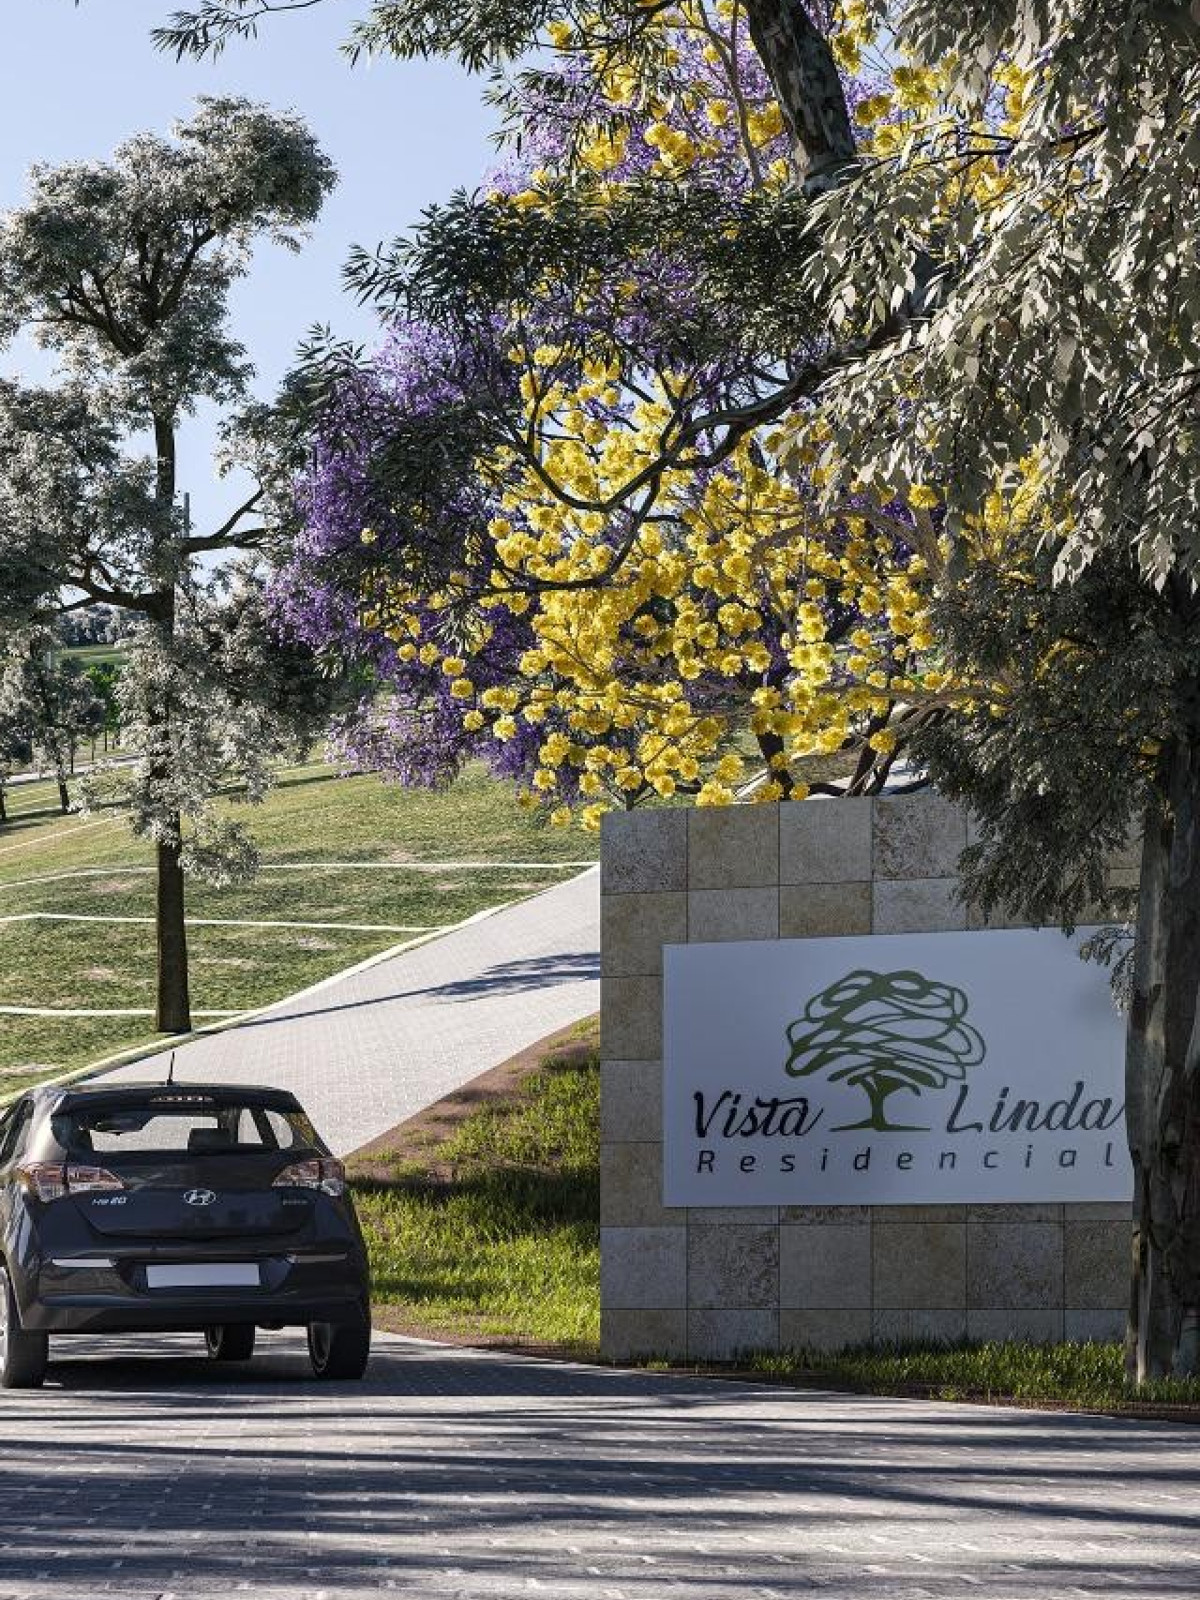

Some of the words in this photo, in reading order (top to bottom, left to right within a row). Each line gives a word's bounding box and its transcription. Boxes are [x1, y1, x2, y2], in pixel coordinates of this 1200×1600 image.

[693, 1090, 824, 1138] Vista
[946, 1081, 1126, 1133] Linda
[697, 1142, 1113, 1174] Residencial
